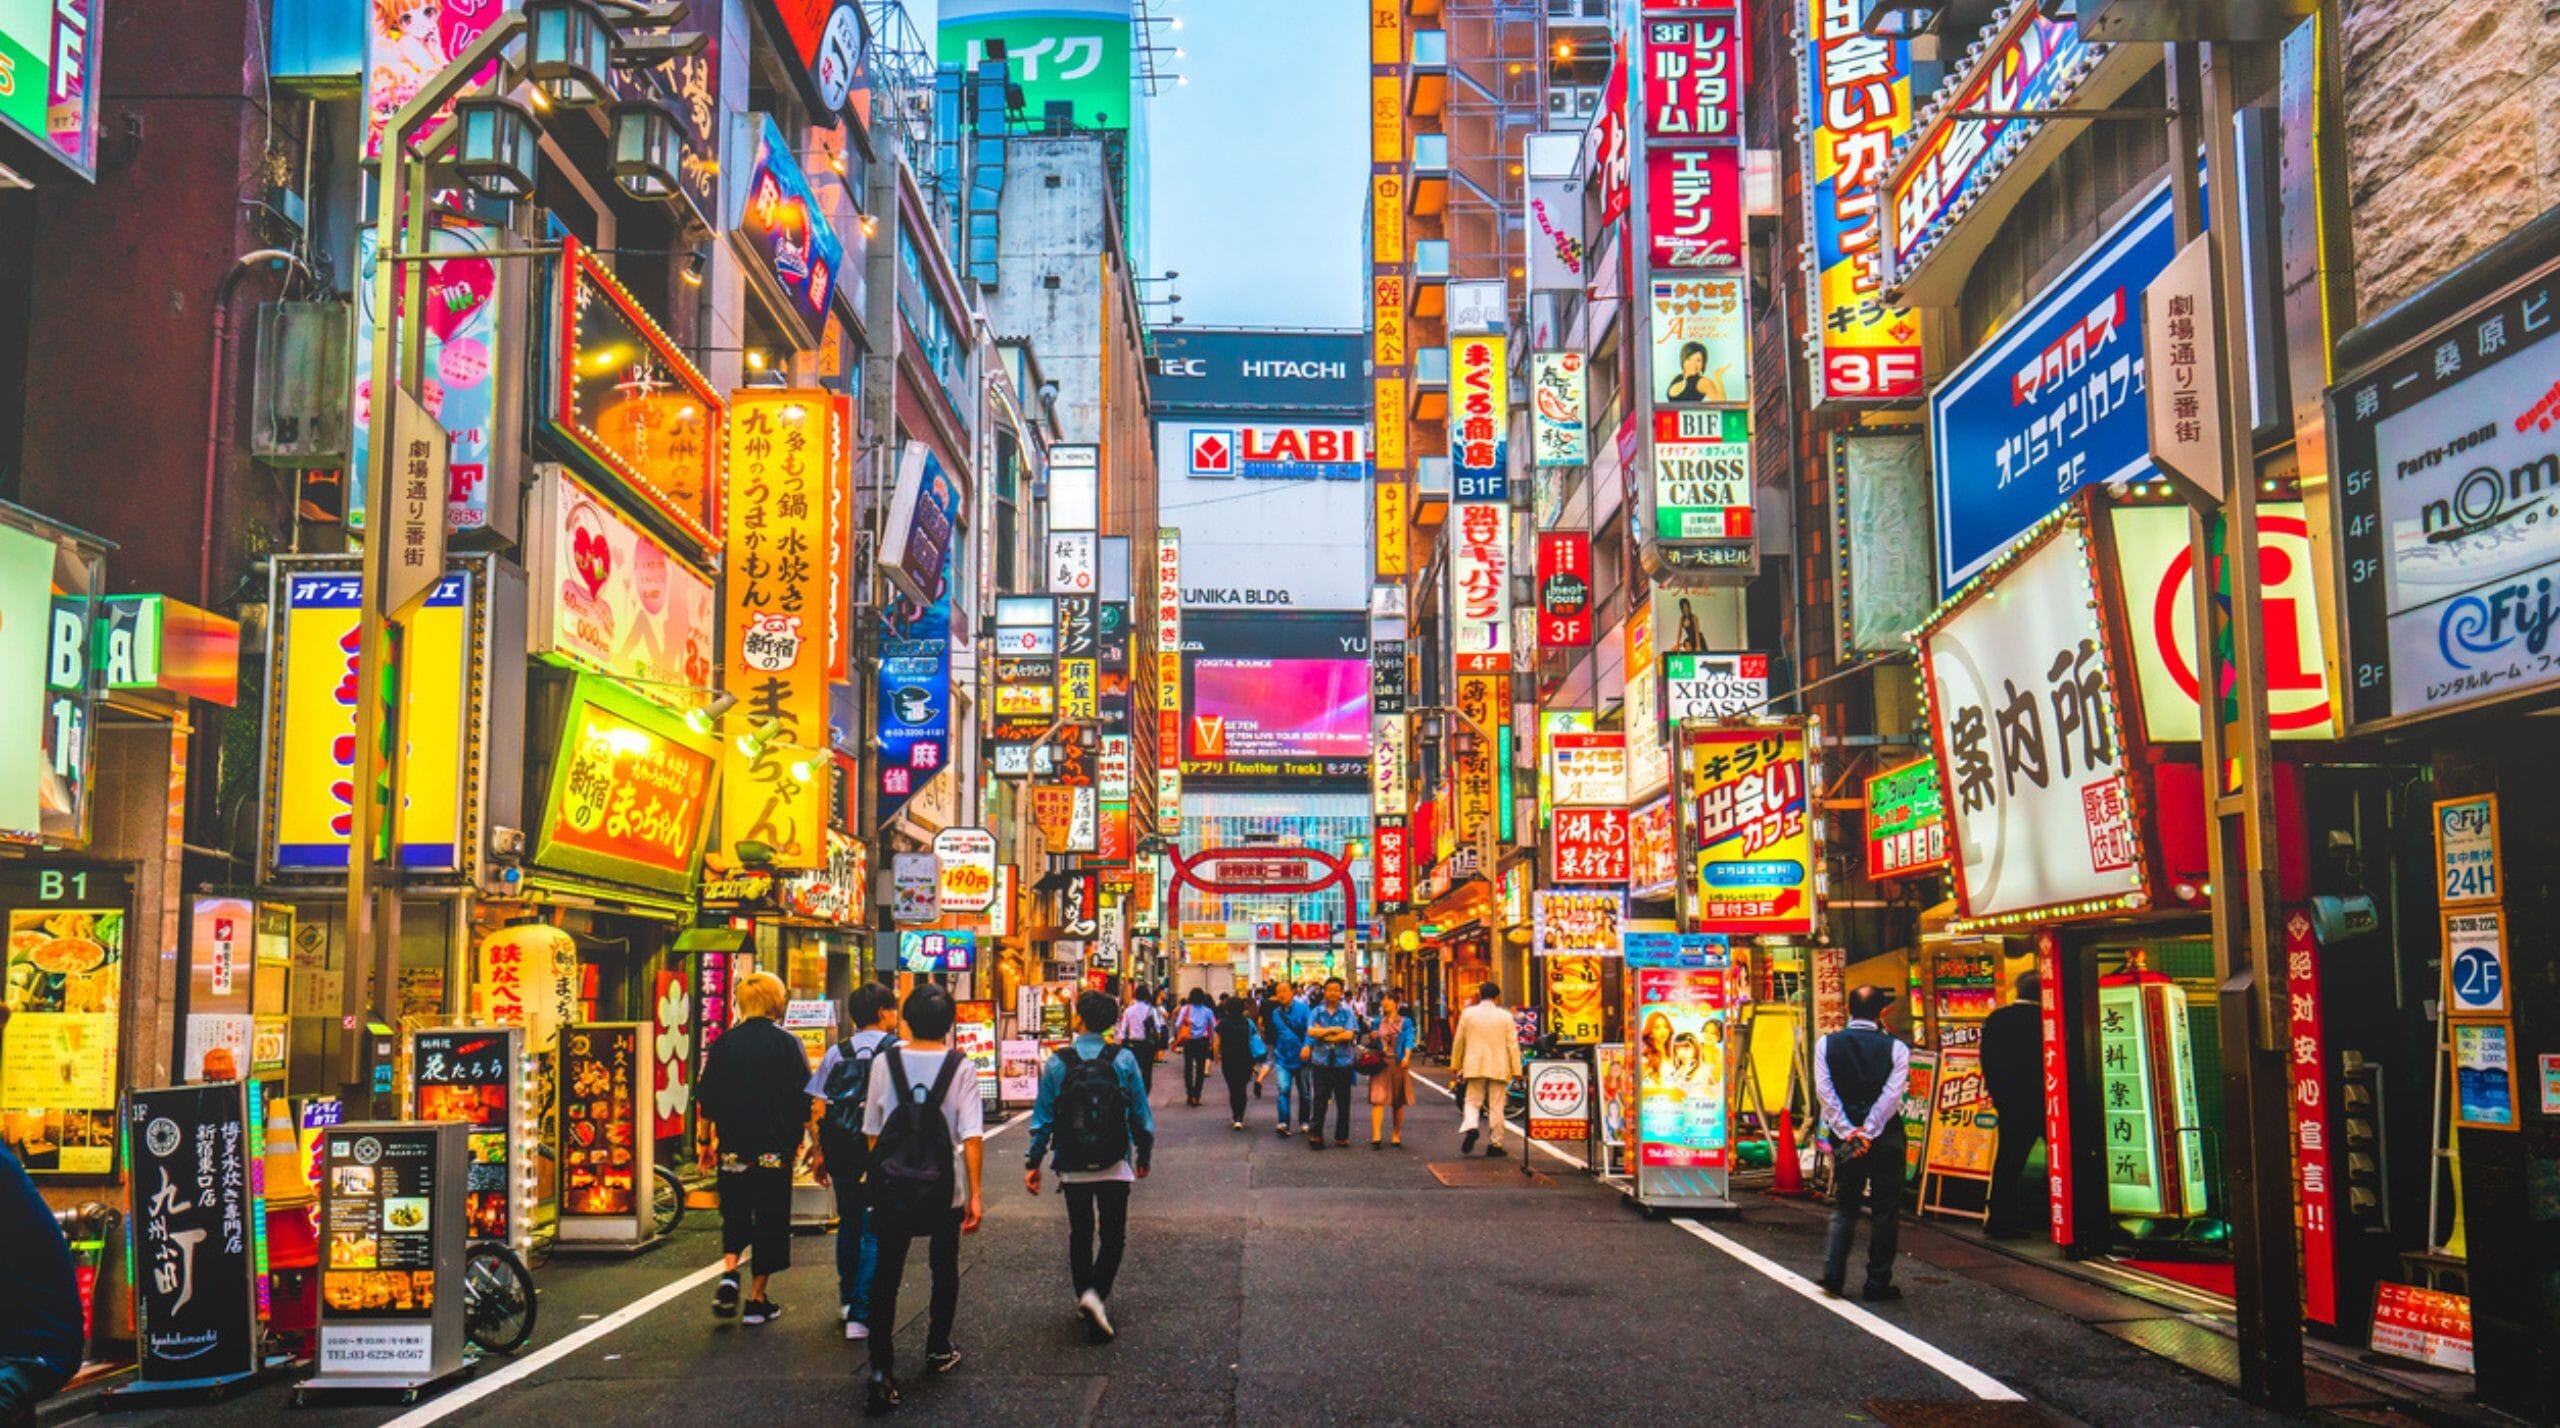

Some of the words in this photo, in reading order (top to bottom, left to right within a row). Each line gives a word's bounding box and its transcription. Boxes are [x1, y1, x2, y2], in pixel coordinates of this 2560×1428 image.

[1655, 24, 1686, 41] 3F
[1655, 51, 1691, 133] ルーム
[1693, 21, 1729, 134] レンタル
[1671, 151, 1711, 236] エデン
[1669, 239, 1736, 268] Eden
[1674, 281, 1737, 299] タイ古式
[1655, 299, 1737, 316] マッサージ
[2017, 292, 2119, 405] マクロス
[2354, 289, 2551, 421] 第一桑原ビ
[1242, 360, 1346, 379] HITACHI
[1830, 353, 1916, 393] 3F
[2168, 293, 2201, 444] 劇場通り一番街
[1463, 343, 1494, 468] まぐろ商店
[1994, 351, 2145, 491] オンラインカフェ
[1682, 413, 1719, 437] B1F
[1241, 428, 1355, 462] LABI
[2397, 419, 2499, 481] Party-room
[1659, 458, 1745, 482] XROSS
[2056, 451, 2087, 495] 2F
[2346, 470, 2373, 497] 5F
[1458, 477, 1503, 495] B1F
[1668, 482, 1736, 506] CASA
[403, 440, 430, 567] 劇場通り一番街
[741, 407, 772, 608] 九州のうまかもん
[2348, 513, 2376, 540] 4F
[776, 528, 809, 612] 水炊き
[1550, 575, 1588, 596] meat
[2351, 558, 2379, 585] 3F
[1160, 546, 1178, 643] お好み焼き
[1245, 589, 1293, 605] BLDG.
[1546, 589, 1585, 614] house
[1551, 620, 1580, 643] 3F
[745, 632, 796, 669] 新宿の
[1470, 655, 1497, 670] 4F
[1069, 661, 1091, 699] 麻雀
[1675, 681, 1761, 699] XROSS
[2358, 662, 2386, 689] 2F
[1070, 702, 1092, 719] 2F
[1685, 699, 1753, 718] CASA
[1950, 638, 2113, 818] 案内所
[744, 676, 802, 852] まっちゃん
[1559, 764, 1624, 776] マッサージ
[1703, 732, 1785, 782] キラリ
[571, 756, 612, 827] 新宿の
[1702, 763, 1799, 840] 出会い
[607, 783, 690, 859] まっちゃん
[1558, 810, 1626, 847] 湖南
[1742, 813, 1805, 858] カフェ
[1380, 832, 1402, 899] 安楽亭
[1559, 848, 1611, 878] 菜館
[40, 871, 87, 899] B1
[2446, 866, 2495, 898] 24H
[1383, 902, 1401, 912] 2F
[1710, 901, 1774, 917] 受付3F
[1273, 922, 1331, 941] LABI
[2459, 953, 2499, 995] 2F
[1576, 1023, 1600, 1038] B1
[421, 1052, 504, 1081] 花たろう
[2101, 1008, 2136, 1183] 無料案内所
[1530, 1127, 1586, 1140] COFFEE
[1938, 1109, 1974, 1128] キラリ
[197, 1124, 217, 1208] 新宿東口店
